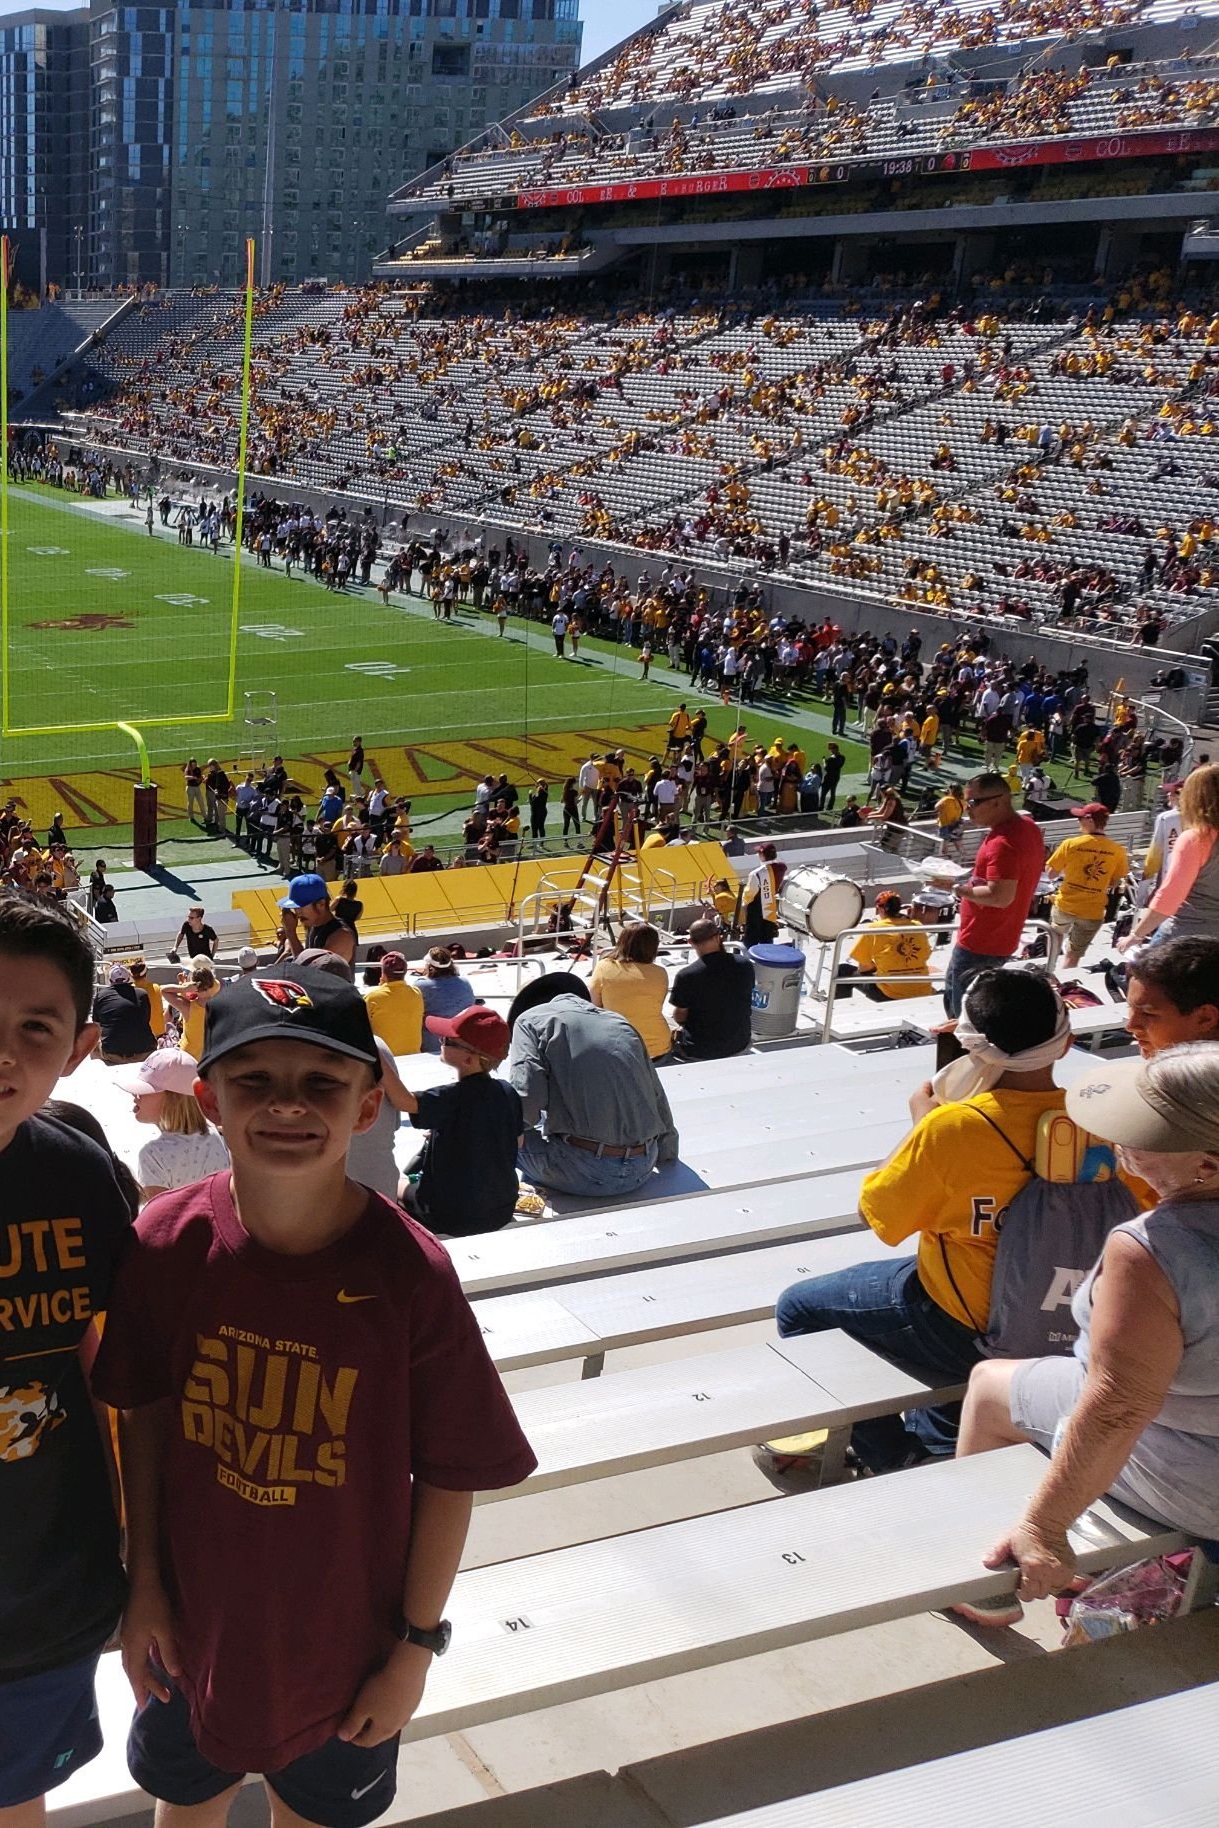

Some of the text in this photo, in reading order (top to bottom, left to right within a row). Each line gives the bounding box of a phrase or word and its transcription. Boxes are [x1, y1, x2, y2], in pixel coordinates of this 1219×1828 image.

[883, 159, 912, 176] 19:38
[928, 157, 936, 170] 0
[836, 167, 844, 180] 0
[154, 593, 210, 607] 30
[239, 623, 306, 639] 20
[344, 661, 412, 676] 10
[970, 1196, 1010, 1237] Fo
[797, 1266, 811, 1274] 10
[218, 1325, 318, 1359] ARIZONA STATE
[184, 1332, 359, 1437] SUN
[691, 1392, 712, 1402] 12
[182, 1403, 347, 1488] DEVILS
[217, 1467, 290, 1504] FOOTBALL
[782, 1551, 808, 1565] 13
[505, 1617, 531, 1632] 14
